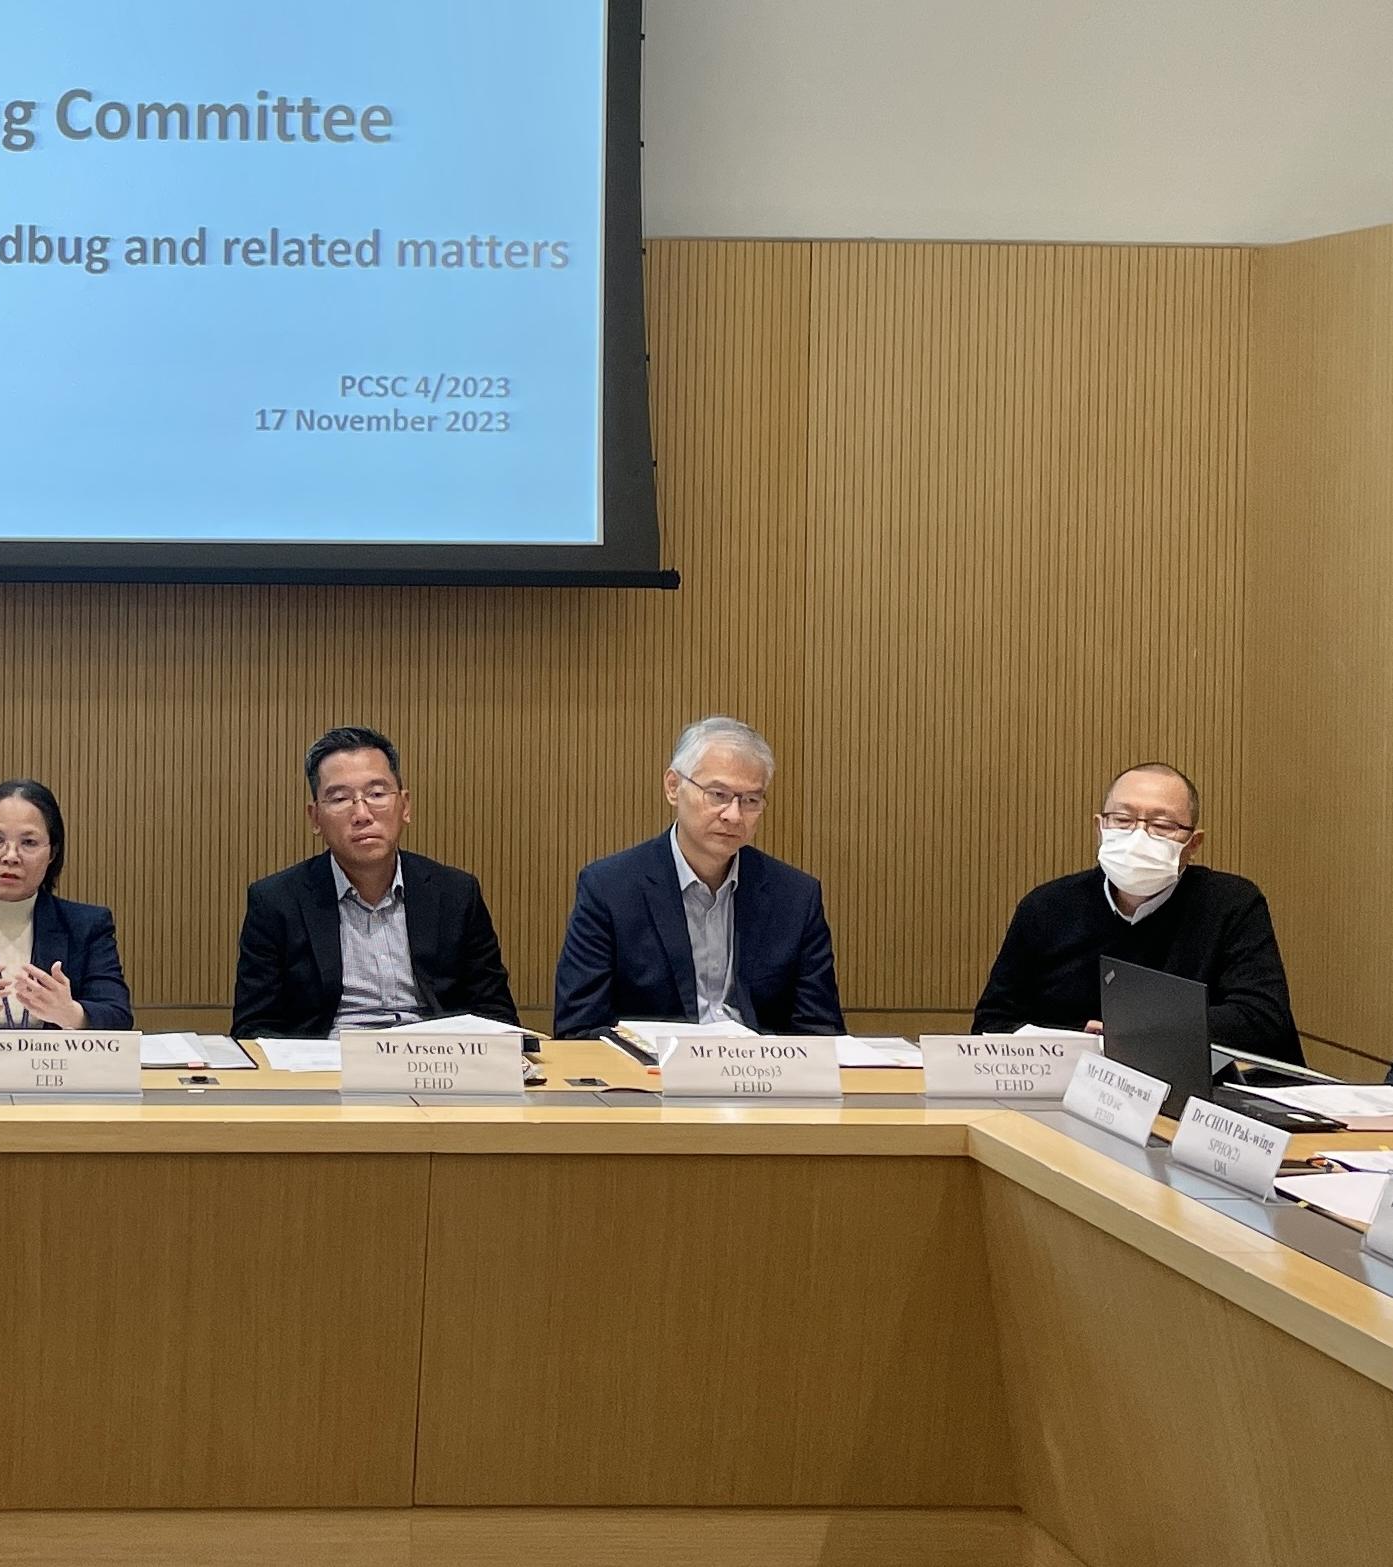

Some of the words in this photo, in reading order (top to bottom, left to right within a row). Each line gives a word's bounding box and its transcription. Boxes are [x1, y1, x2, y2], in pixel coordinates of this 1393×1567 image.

[56, 89, 393, 143] Committee
[125, 227, 206, 266] and
[224, 228, 380, 267] related
[398, 235, 570, 268] matters
[341, 376, 408, 397] PCSC
[415, 373, 511, 403] 4/2023
[256, 409, 288, 430] 17
[296, 408, 439, 432] November
[446, 411, 510, 432] 2023
[19, 1039, 59, 1051] Diane
[65, 1039, 121, 1052] WONG
[377, 1042, 398, 1053] Mr
[404, 1043, 449, 1055] Arsene
[457, 1043, 490, 1055] YIU
[691, 1046, 712, 1057] Mr
[718, 1046, 755, 1058] Peter
[761, 1046, 809, 1059] POON
[958, 1044, 979, 1056] Mr
[985, 1043, 1035, 1057] Wilson
[1040, 1044, 1066, 1057] NG
[31, 1058, 68, 1072] USEE
[408, 1062, 458, 1076] DD(EH)
[721, 1065, 782, 1082] AD(Ops)3
[1099, 1069, 1115, 1086] LEE
[36, 1075, 63, 1087] EEB
[414, 1078, 453, 1089] FEHD
[734, 1082, 773, 1093] FEHD
[995, 1080, 1034, 1091] FEHD
[1192, 1108, 1205, 1123] Dr
[1205, 1114, 1233, 1135] CHIM
[1233, 1124, 1275, 1154] Pak-wing
